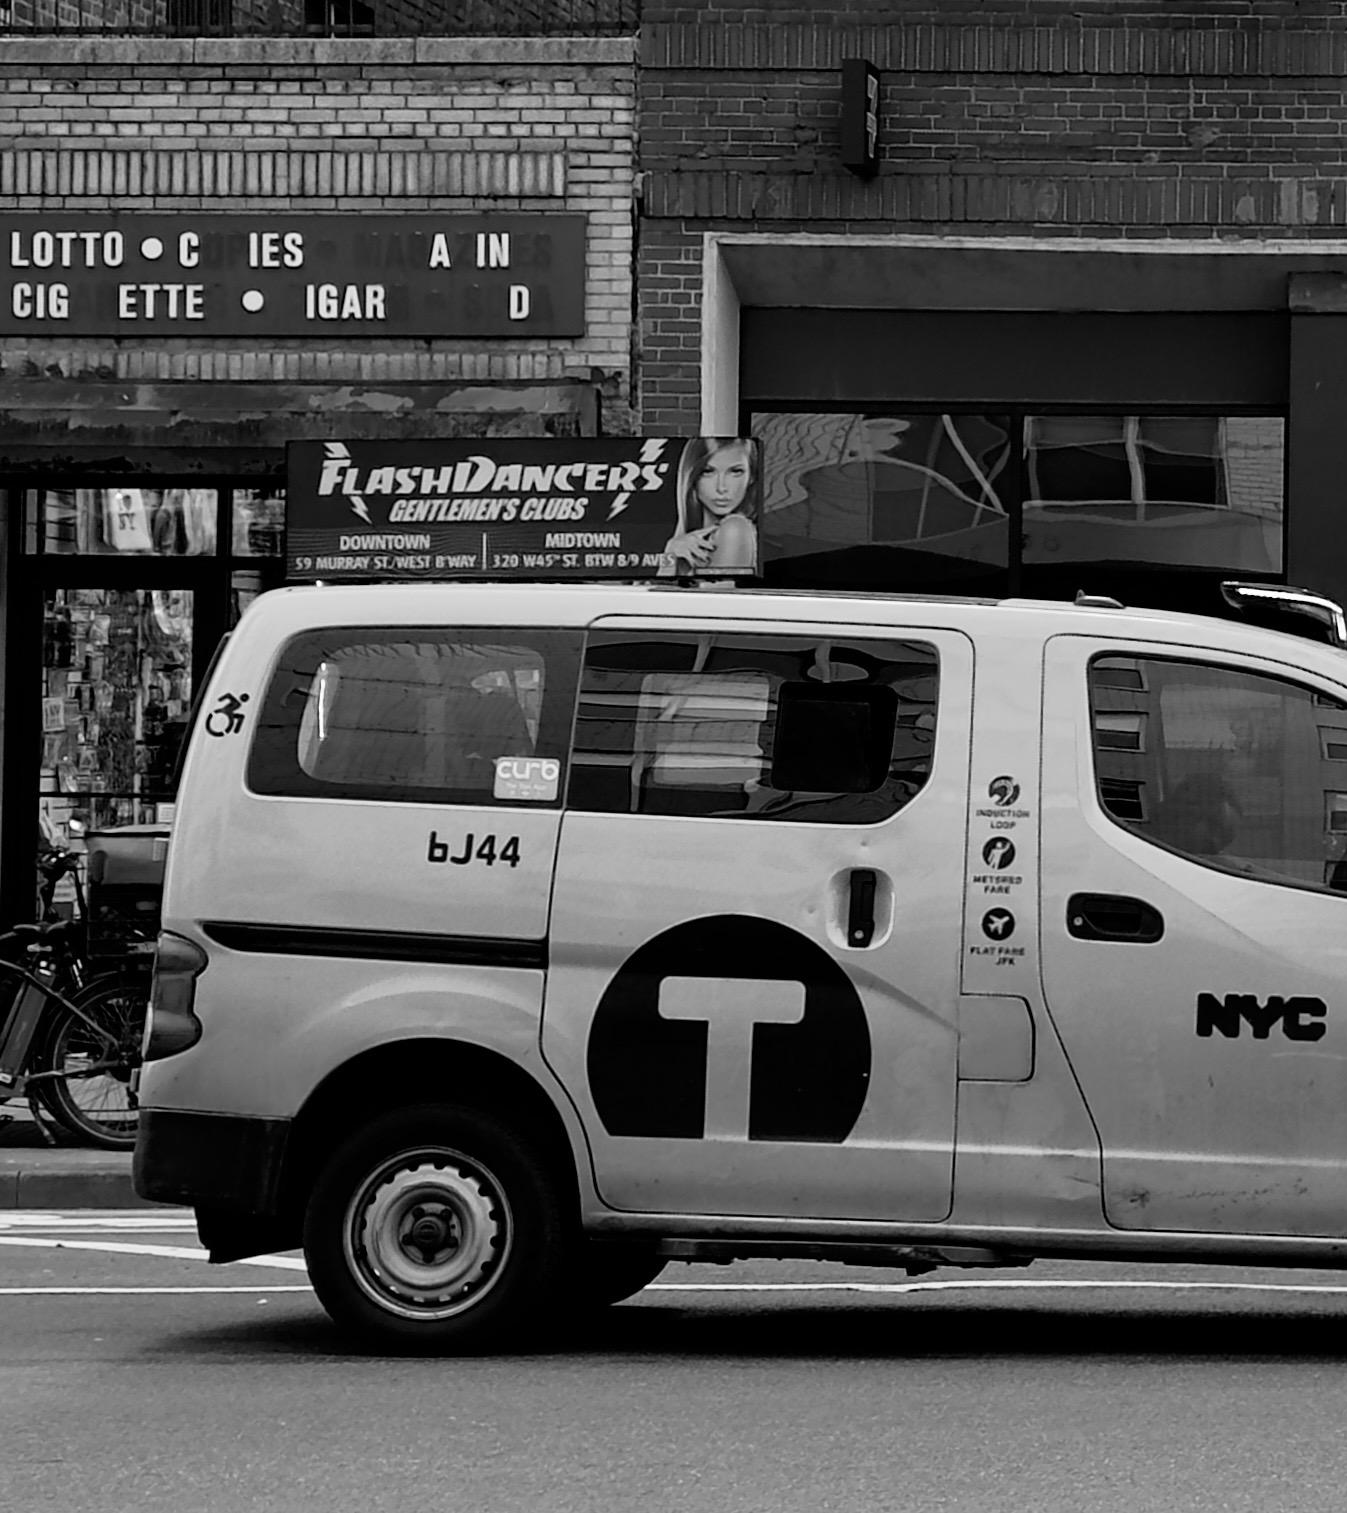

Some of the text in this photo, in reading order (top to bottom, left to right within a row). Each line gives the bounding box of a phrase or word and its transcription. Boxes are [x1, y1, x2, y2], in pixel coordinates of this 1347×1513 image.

[10, 231, 124, 268] LOTTO
[388, 496, 589, 523] GENTLEMEN'S CLUBS
[339, 534, 431, 551] DOWNTOWN
[544, 532, 621, 548] MIDTOWN
[295, 556, 312, 571] 59
[315, 556, 370, 570] MURRAY
[492, 553, 520, 567] 320
[584, 553, 614, 567] BTW
[616, 553, 638, 567] 8/9
[496, 760, 559, 781] curb
[975, 809, 1030, 818] INDUCTION
[990, 820, 1017, 830] LOOP
[983, 885, 1010, 894] FARE
[970, 946, 1025, 956] FLAT FARE
[996, 956, 1015, 966] JFK
[1196, 992, 1328, 1042] NYC
[657, 975, 807, 1141] T
